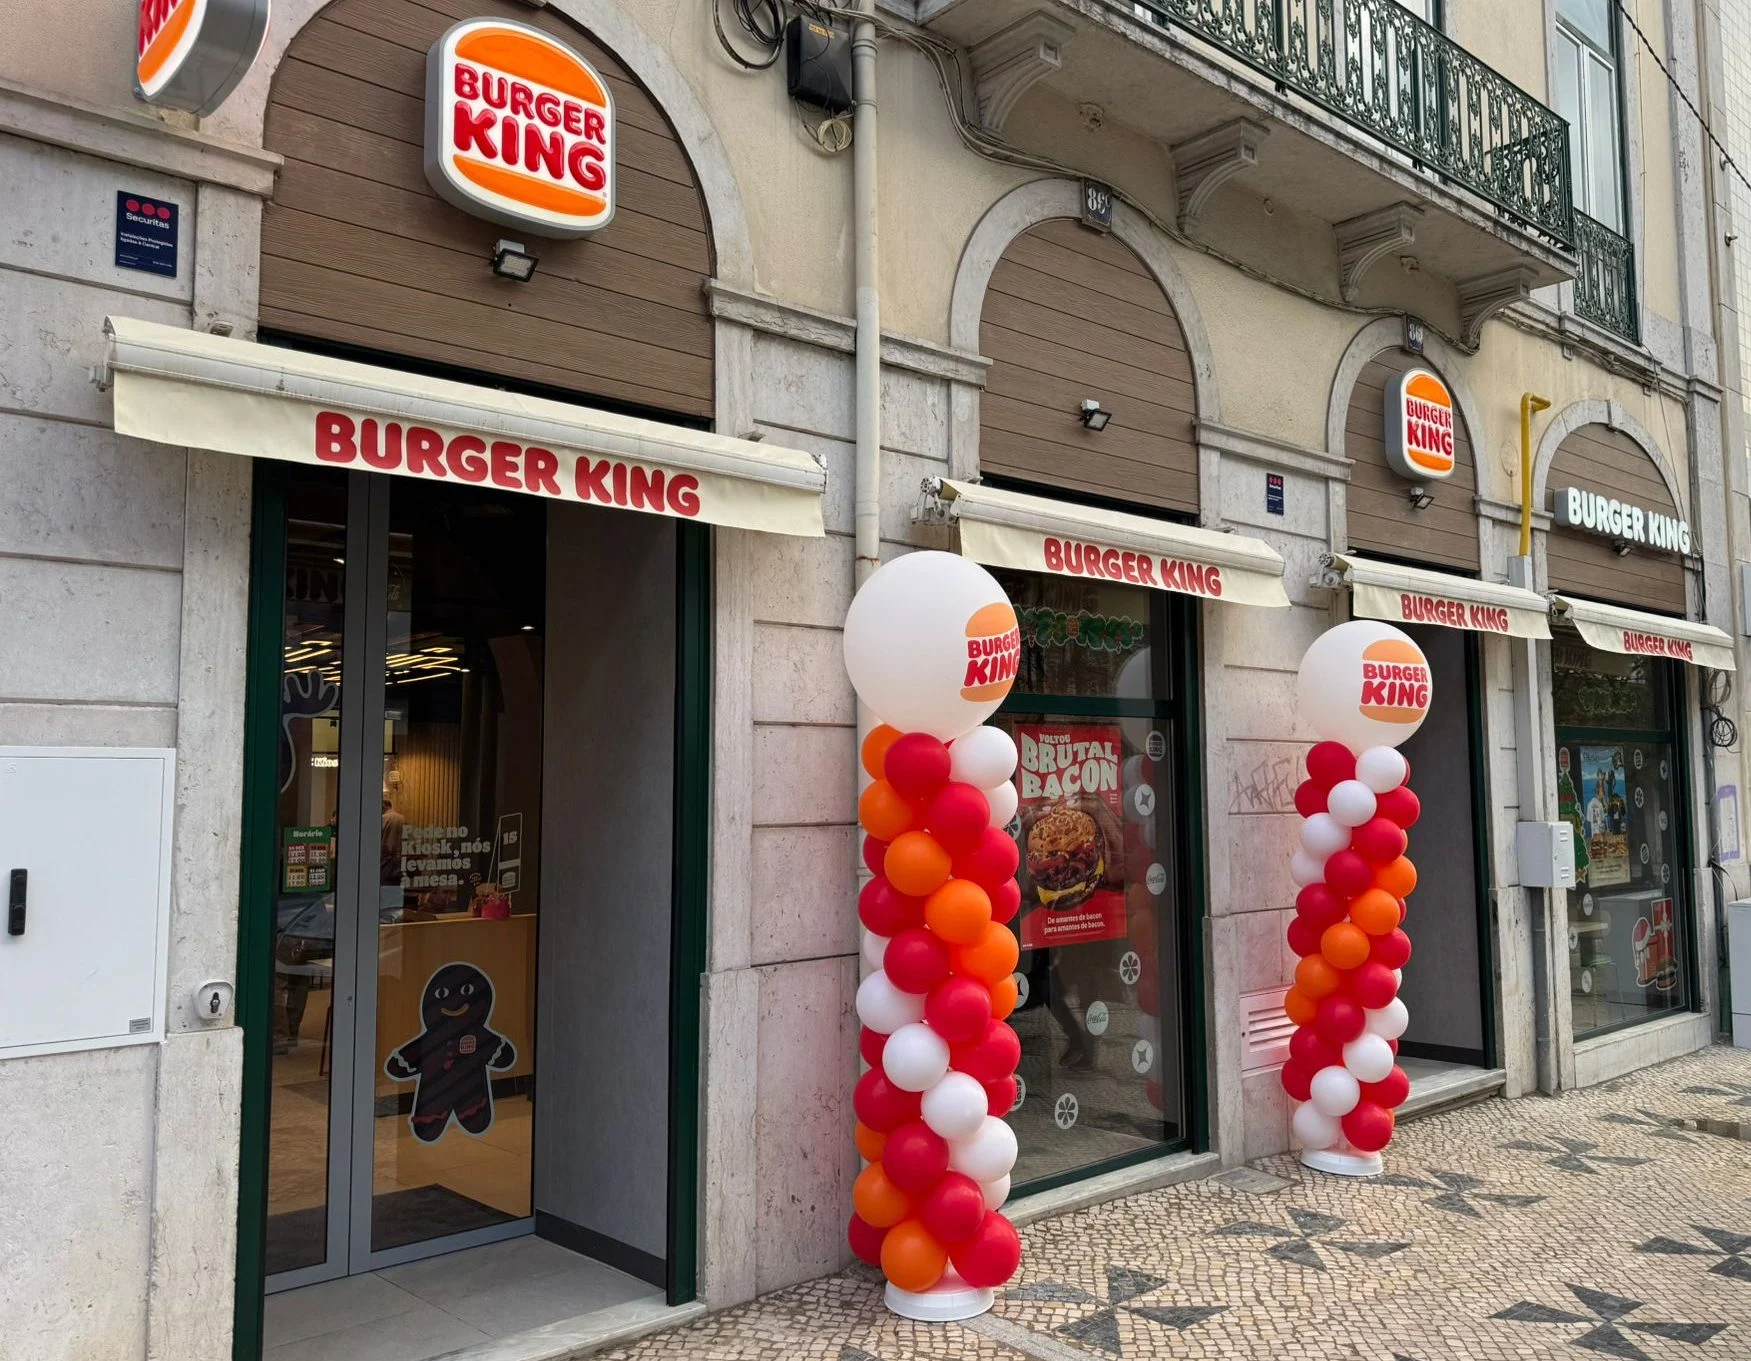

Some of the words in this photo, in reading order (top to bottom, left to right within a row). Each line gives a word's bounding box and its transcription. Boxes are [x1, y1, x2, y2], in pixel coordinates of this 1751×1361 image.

[455, 63, 606, 145] BURGER
[453, 100, 606, 191] KING
[125, 212, 169, 229] Securitas
[1406, 397, 1451, 428] BURGER
[1407, 418, 1453, 456] KING
[315, 411, 562, 496] BURGER
[574, 455, 701, 517] KING
[1568, 486, 1646, 543] BURGER
[1648, 510, 1691, 554] KING
[1044, 537, 1158, 586] BURGER
[1160, 557, 1222, 597] KING
[1400, 593, 1468, 628] BURGER
[1469, 604, 1509, 632] KING
[1623, 631, 1667, 655] BURGER
[1667, 639, 1693, 661] KING
[1363, 663, 1428, 683] BURGER
[1361, 680, 1428, 708] KING
[1039, 733, 1070, 744] VOLTOU
[1021, 732, 1118, 774] BRUTAL
[1021, 759, 1118, 799] BACON
[292, 829, 323, 838] Horário
[401, 824, 446, 839] Pede
[446, 826, 469, 839] no
[460, 837, 491, 853] nós
[503, 831, 518, 845] 15
[400, 857, 471, 872] levamos
[400, 871, 414, 888] à
[414, 873, 465, 888] mesa.
[1044, 926, 1057, 935] para
[1057, 923, 1080, 932] amantes
[1081, 921, 1088, 930] de
[1088, 920, 1106, 929] bacon.
[1056, 914, 1079, 923] amantes
[1079, 913, 1086, 921] de
[1086, 912, 1102, 920] bacon
